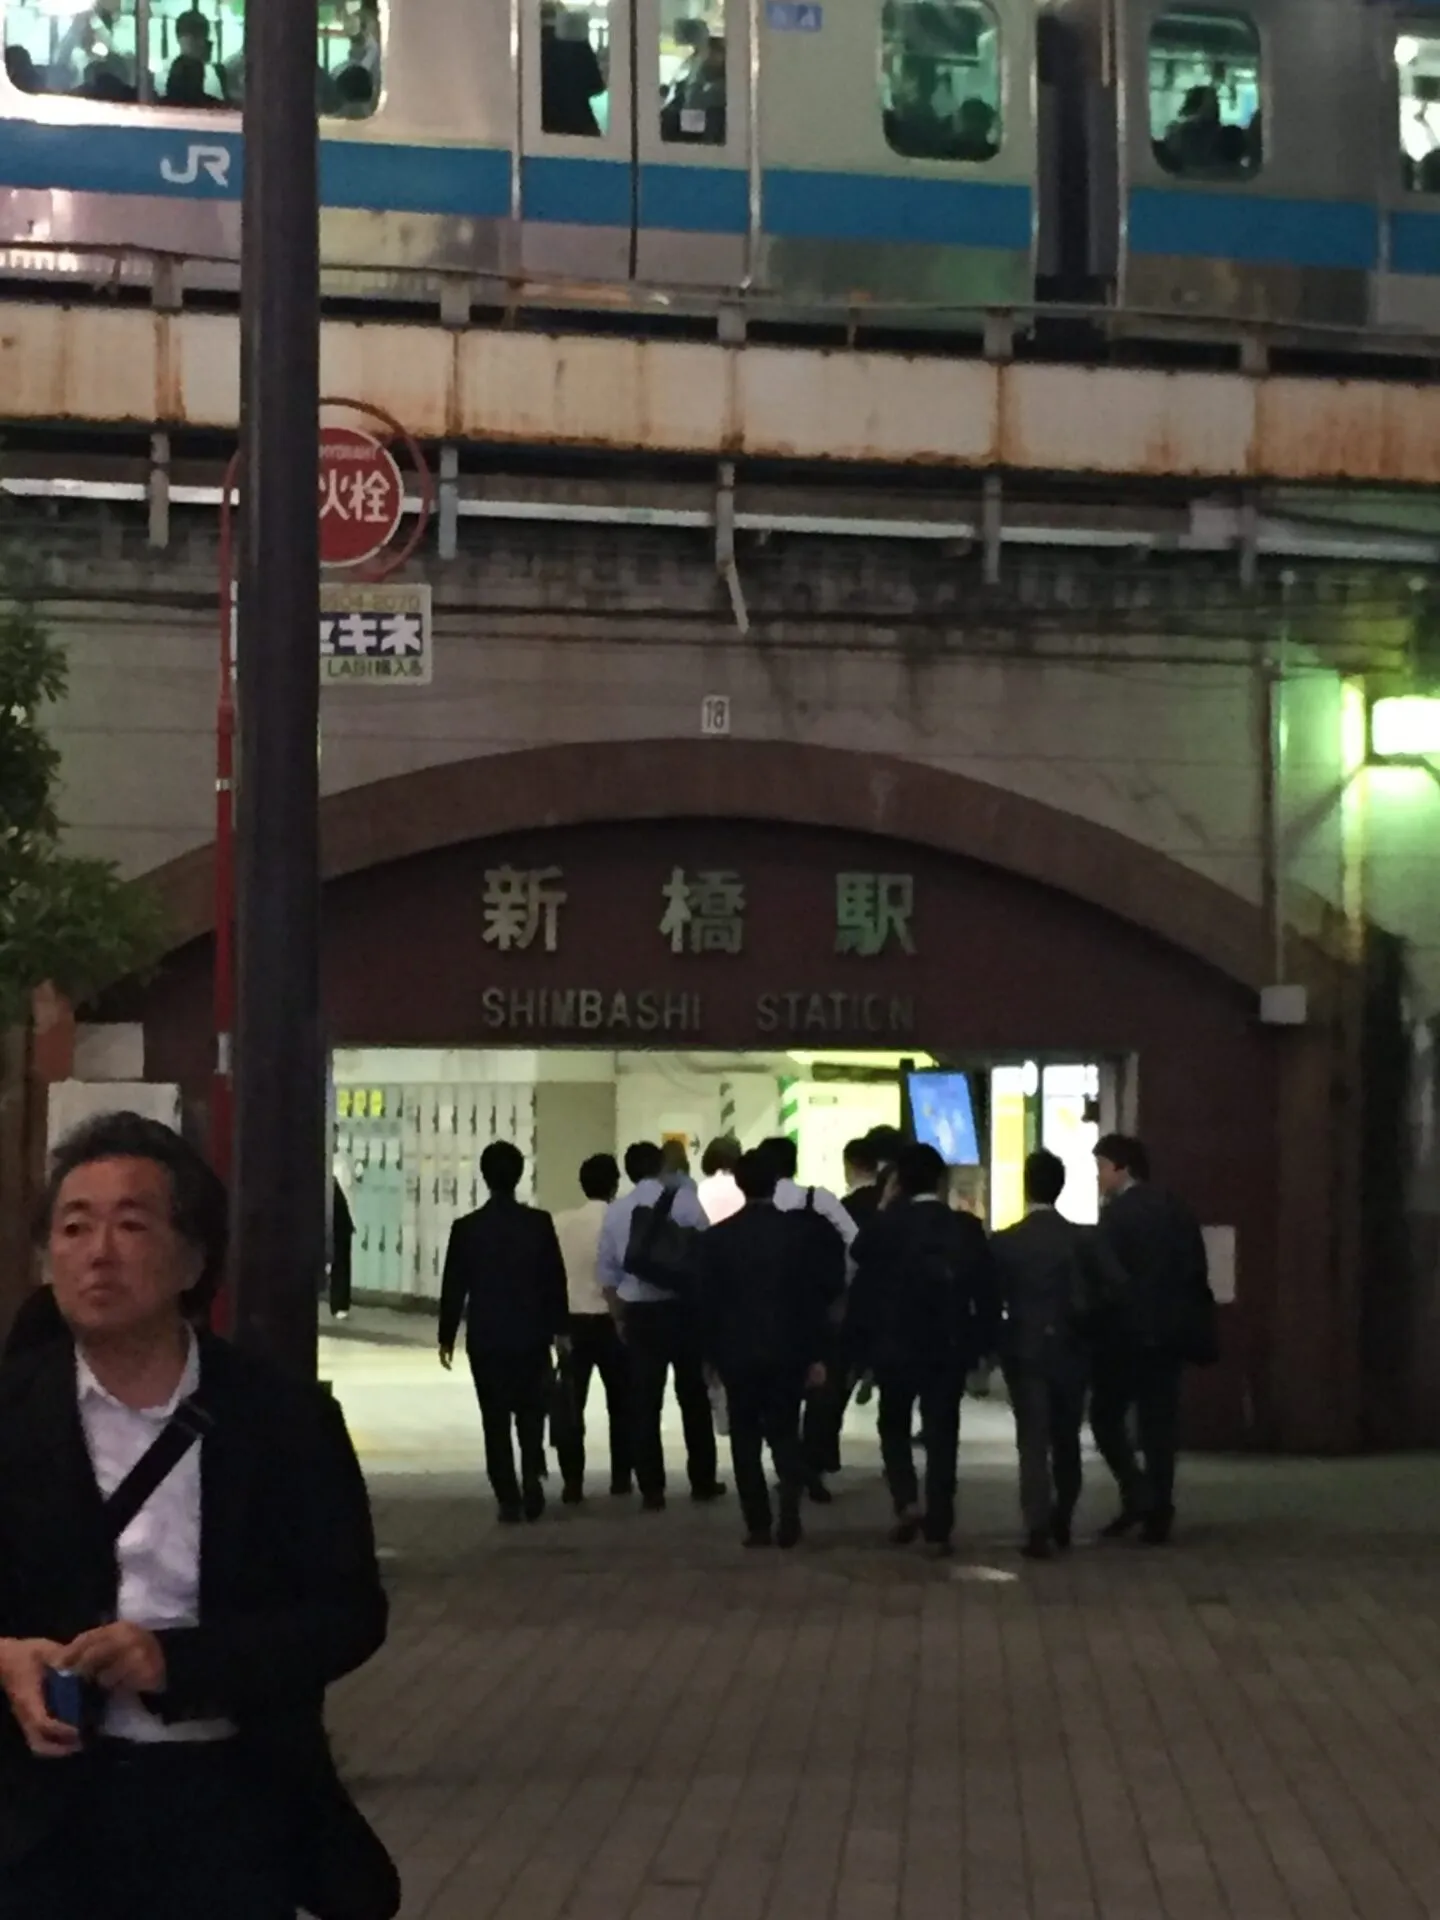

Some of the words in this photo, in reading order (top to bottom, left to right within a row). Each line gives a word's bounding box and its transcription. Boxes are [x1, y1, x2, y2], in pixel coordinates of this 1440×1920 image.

[161, 145, 230, 188] JR
[319, 469, 390, 522] 火栓
[481, 864, 918, 956] 新橋駅
[481, 986, 700, 1029] SHIMBASHI
[755, 989, 915, 1032] STATION
